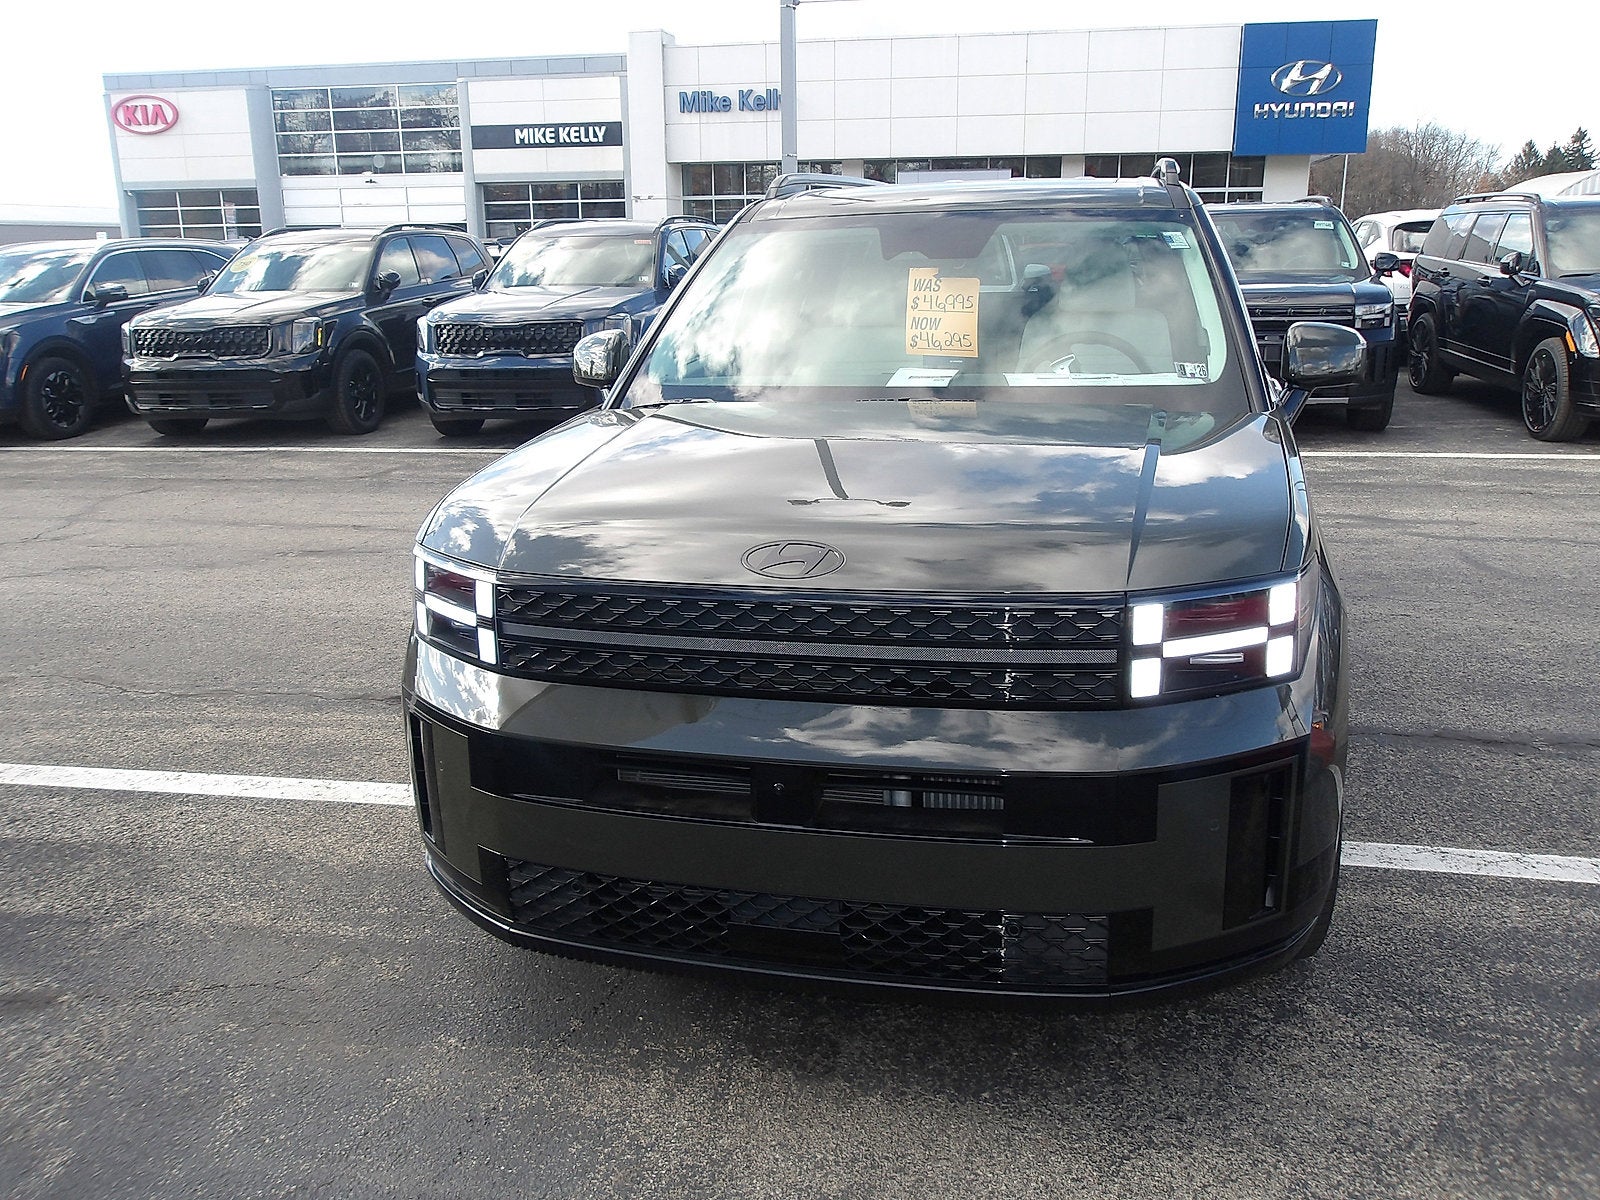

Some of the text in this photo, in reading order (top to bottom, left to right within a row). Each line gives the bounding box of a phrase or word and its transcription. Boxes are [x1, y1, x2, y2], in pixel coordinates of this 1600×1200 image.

[679, 88, 781, 113] Mike Kell
[121, 104, 169, 126] KIA
[1253, 101, 1355, 119] HYUNDAI
[514, 125, 606, 144] MIKE KELLY
[913, 278, 942, 292] WAS
[910, 316, 942, 330] NOW
